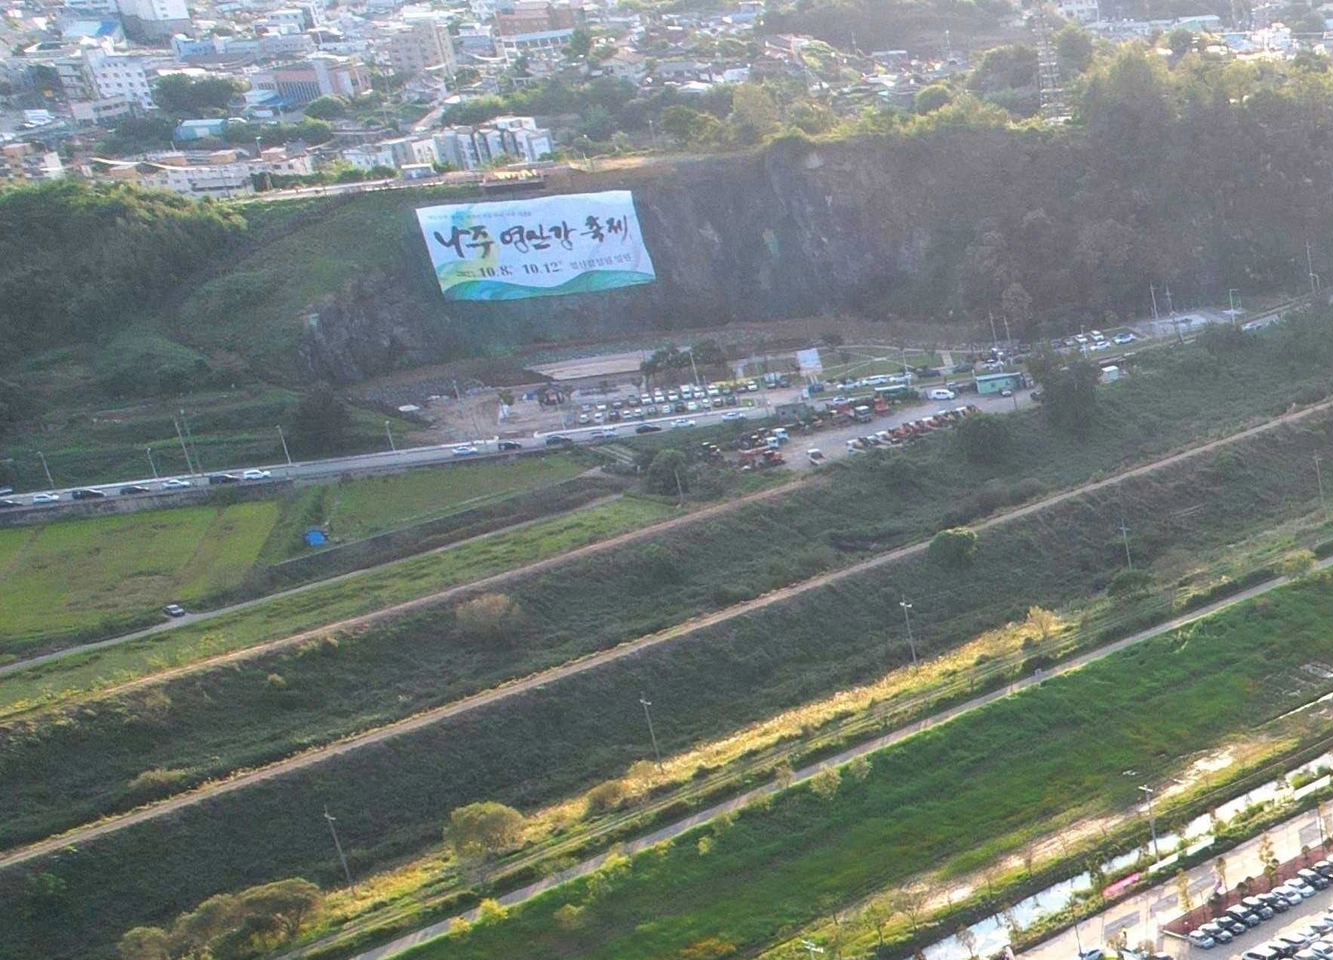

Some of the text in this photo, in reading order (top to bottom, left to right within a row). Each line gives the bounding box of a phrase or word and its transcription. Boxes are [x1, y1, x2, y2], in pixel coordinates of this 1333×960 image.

[433, 214, 627, 259] 나주 영산강 축제
